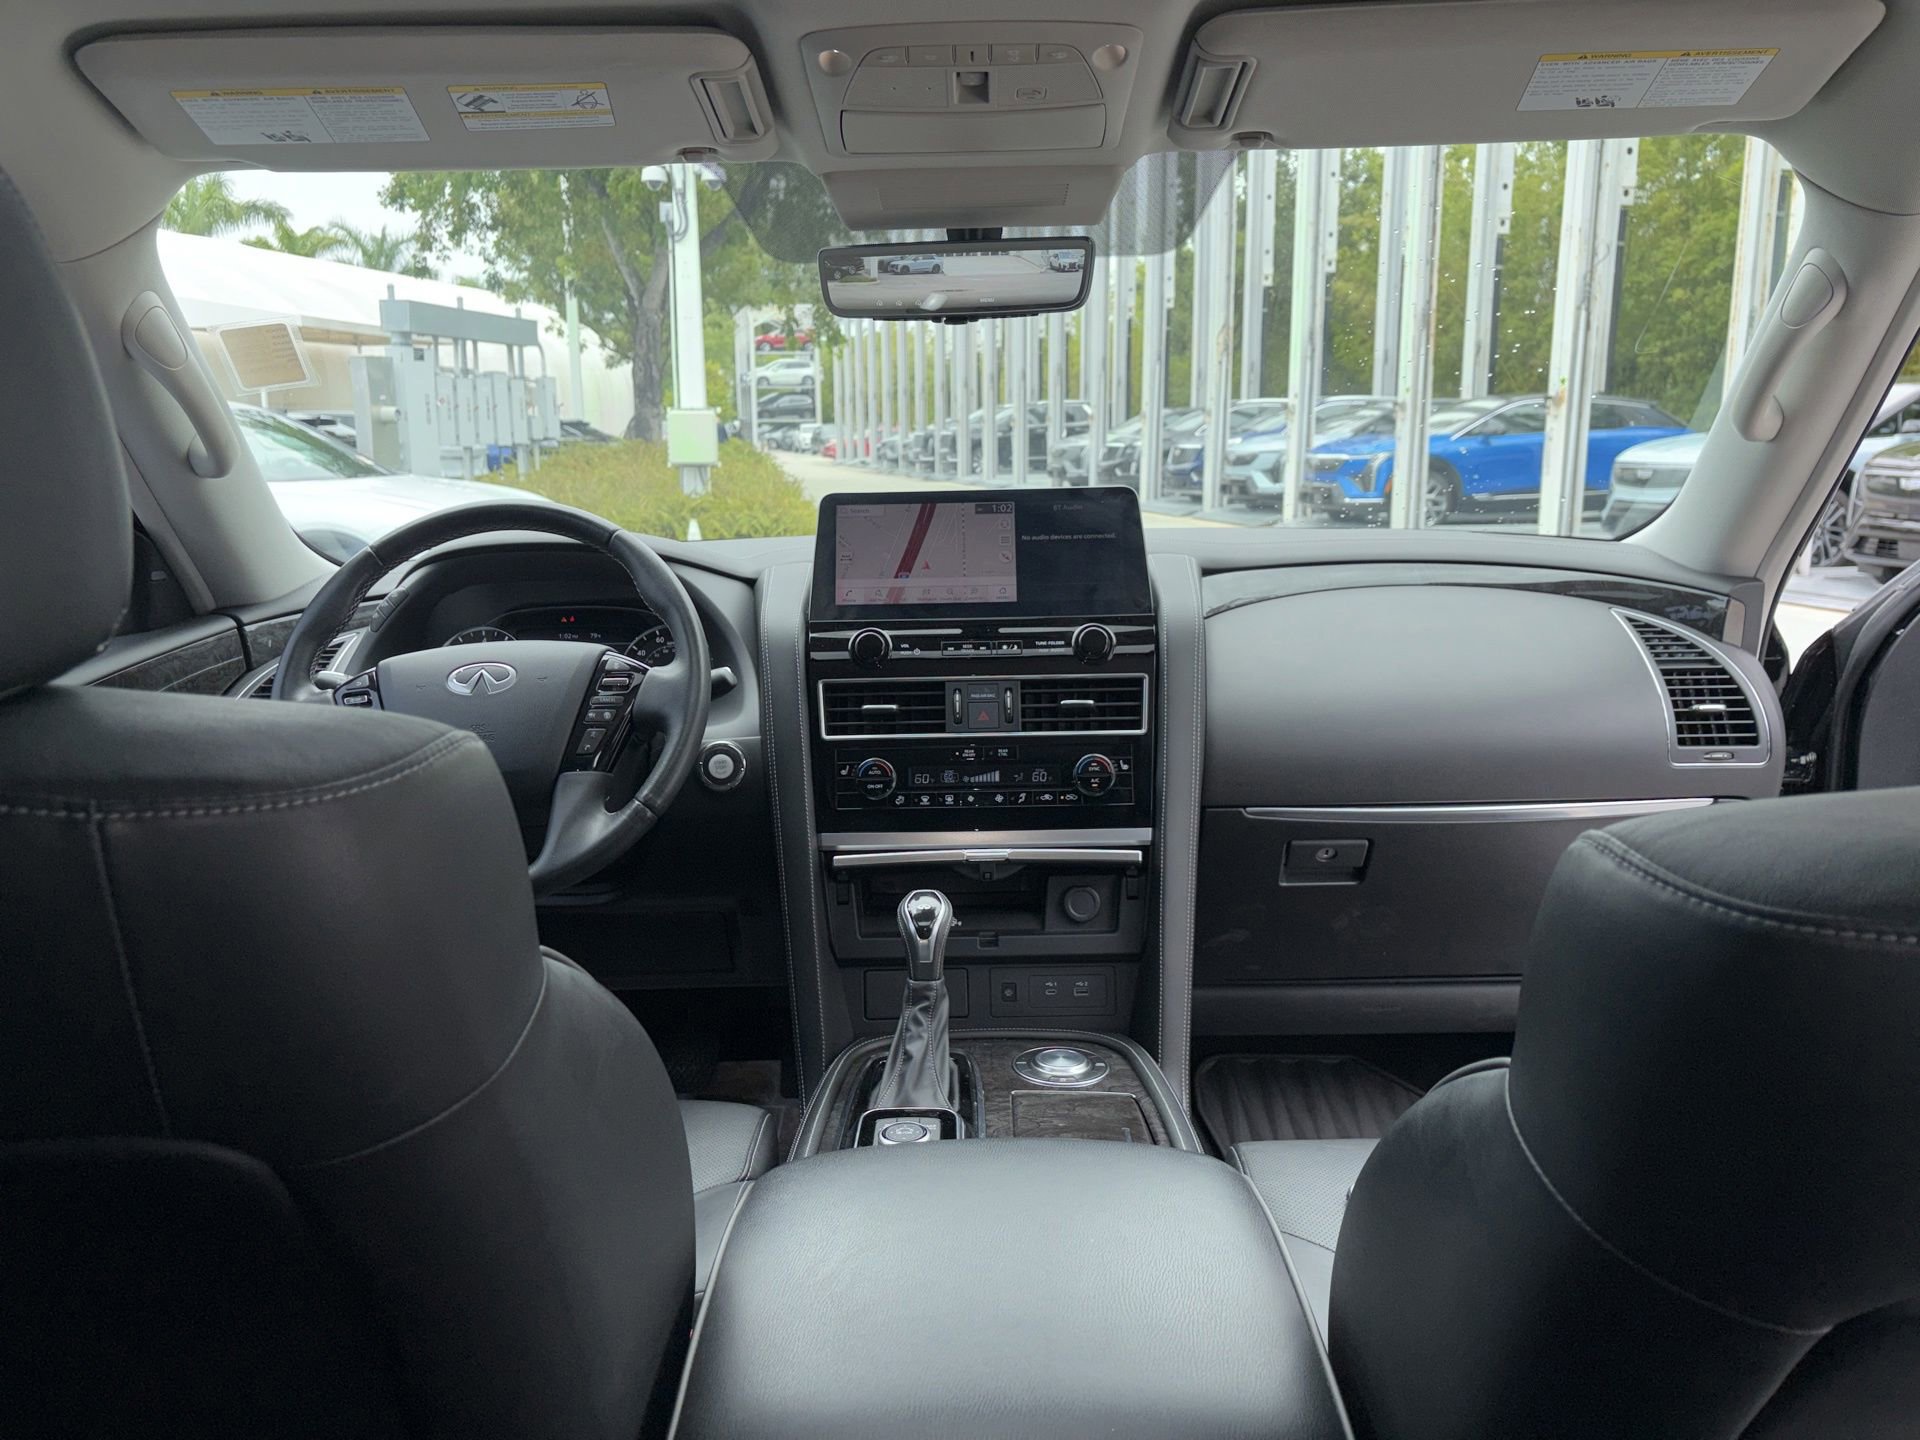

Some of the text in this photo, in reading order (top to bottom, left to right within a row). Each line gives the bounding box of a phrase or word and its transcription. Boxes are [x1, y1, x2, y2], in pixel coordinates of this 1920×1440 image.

[992, 503, 1013, 513] 1:02
[655, 636, 665, 644] 60
[914, 773, 930, 784] 60
[1031, 771, 1048, 783] 60
